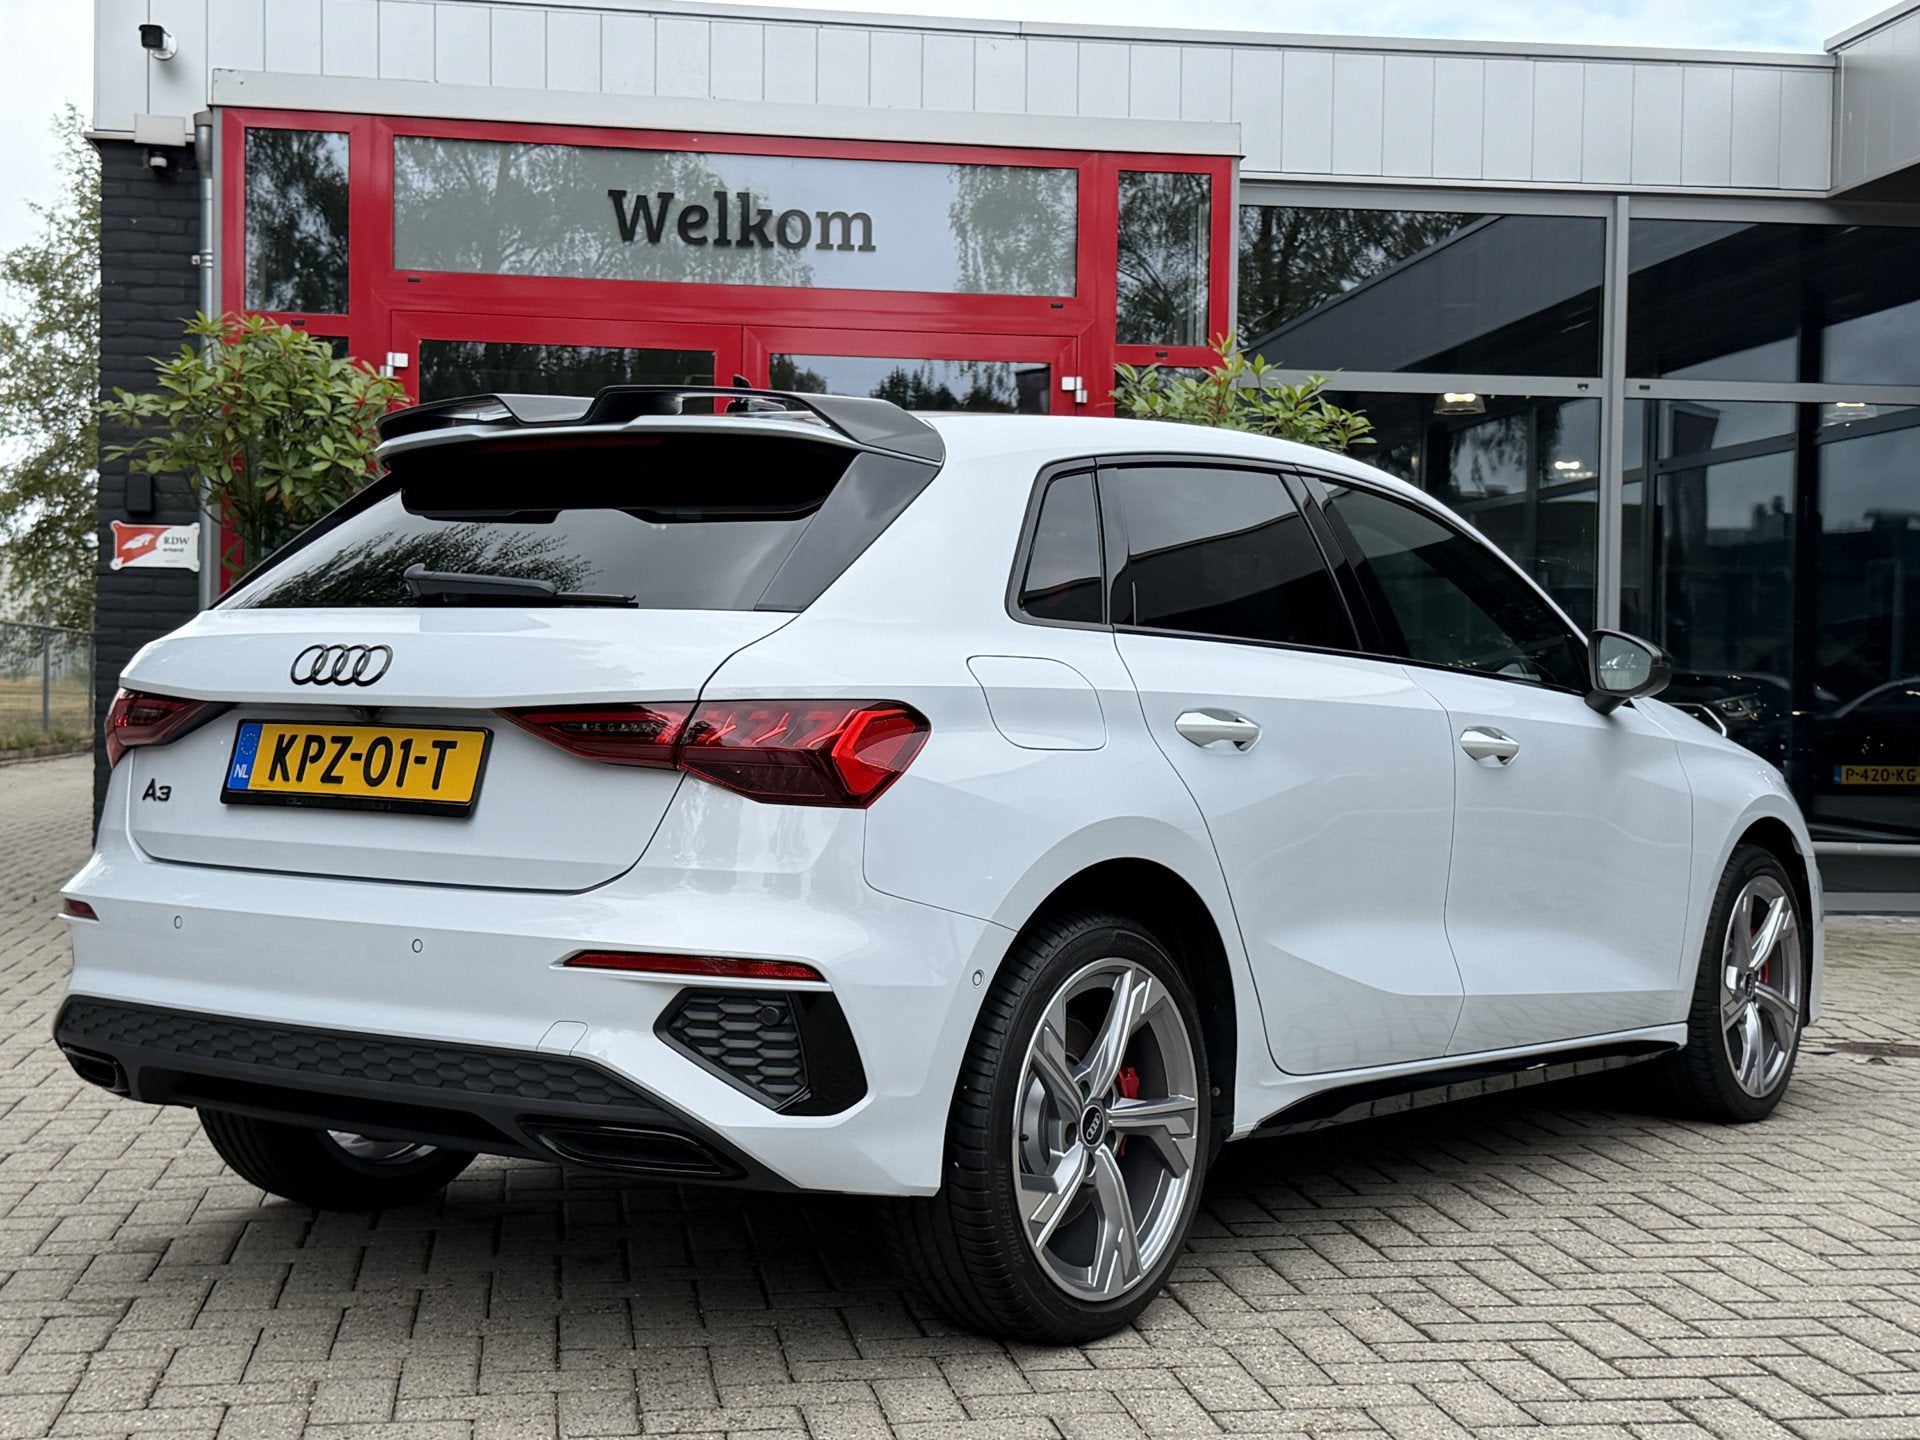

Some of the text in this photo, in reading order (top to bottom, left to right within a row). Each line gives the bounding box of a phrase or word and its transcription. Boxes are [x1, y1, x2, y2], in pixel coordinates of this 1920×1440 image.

[608, 189, 876, 252] Welkom
[164, 536, 189, 545] RDW
[234, 733, 458, 790] NL KPZ-01-T
[1845, 768, 1916, 782] P-420-KG
[142, 778, 172, 801] A3
